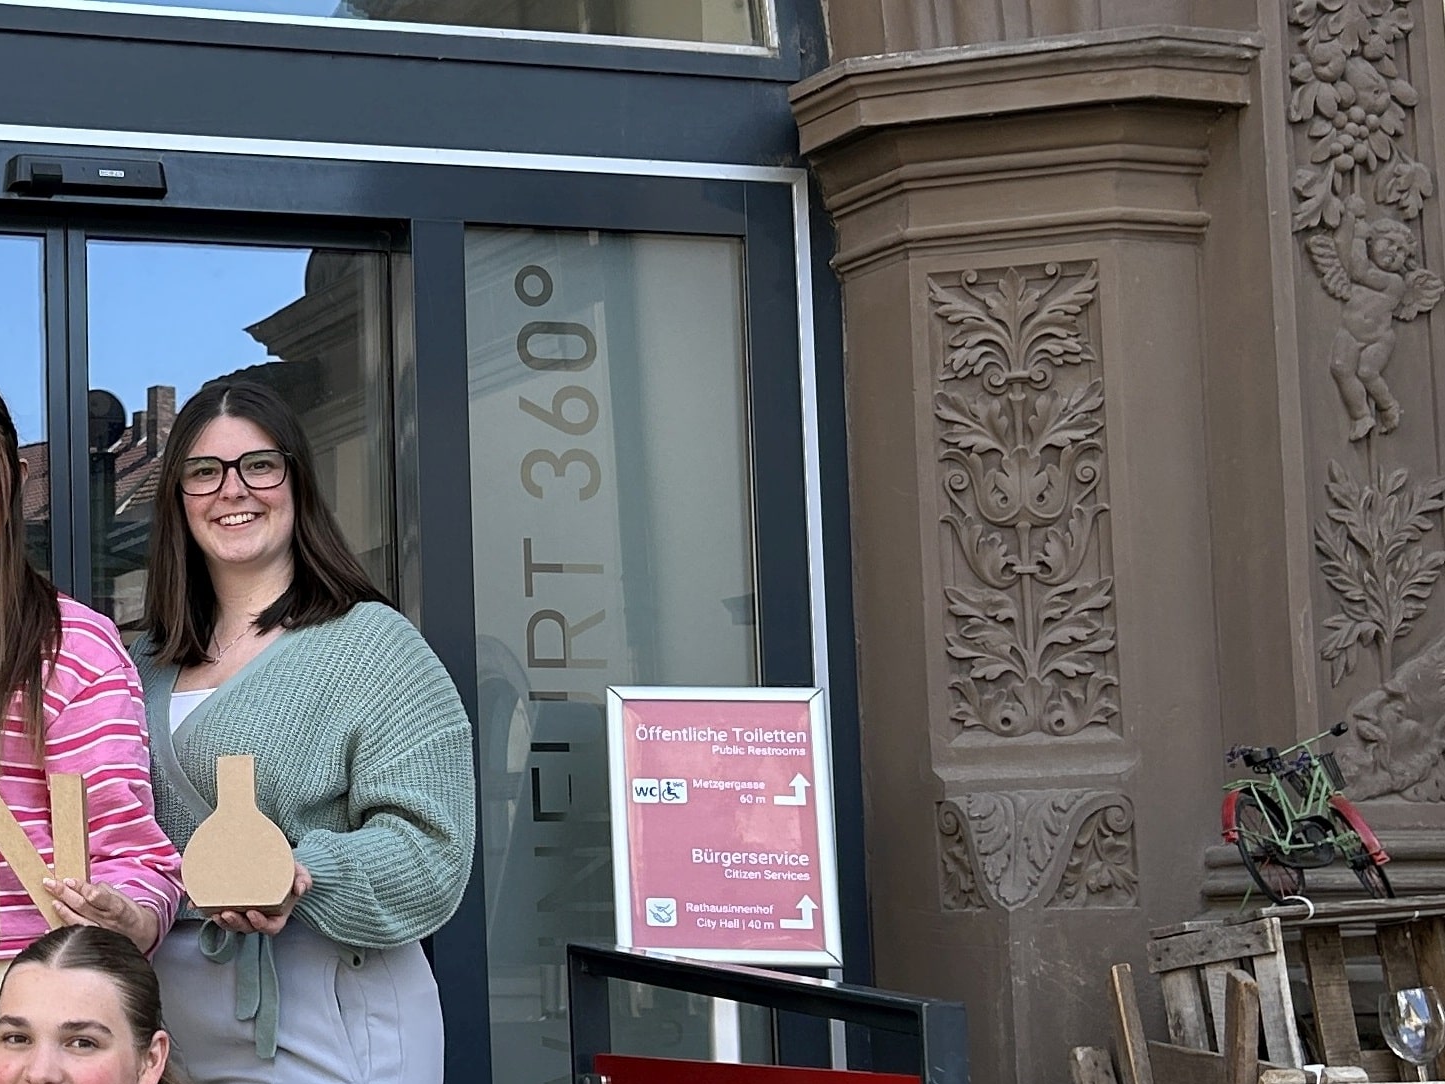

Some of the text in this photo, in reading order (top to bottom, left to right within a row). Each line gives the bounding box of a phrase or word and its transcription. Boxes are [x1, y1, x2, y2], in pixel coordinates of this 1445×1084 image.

[514, 264, 602, 501] 360°
[635, 724, 807, 743] Öffentliche Toiletten
[712, 745, 806, 756] Public Restrooms
[692, 779, 766, 791] Metzgergasse
[635, 786, 657, 797] WC
[740, 795, 766, 804] 60 m
[692, 848, 810, 867] Bürgerservice
[724, 869, 811, 881] Citizen Services
[686, 902, 774, 915] Rathausinnenhof
[696, 918, 717, 930] City
[719, 919, 740, 929] Hall
[747, 920, 761, 929] 40
[763, 921, 775, 929] m
